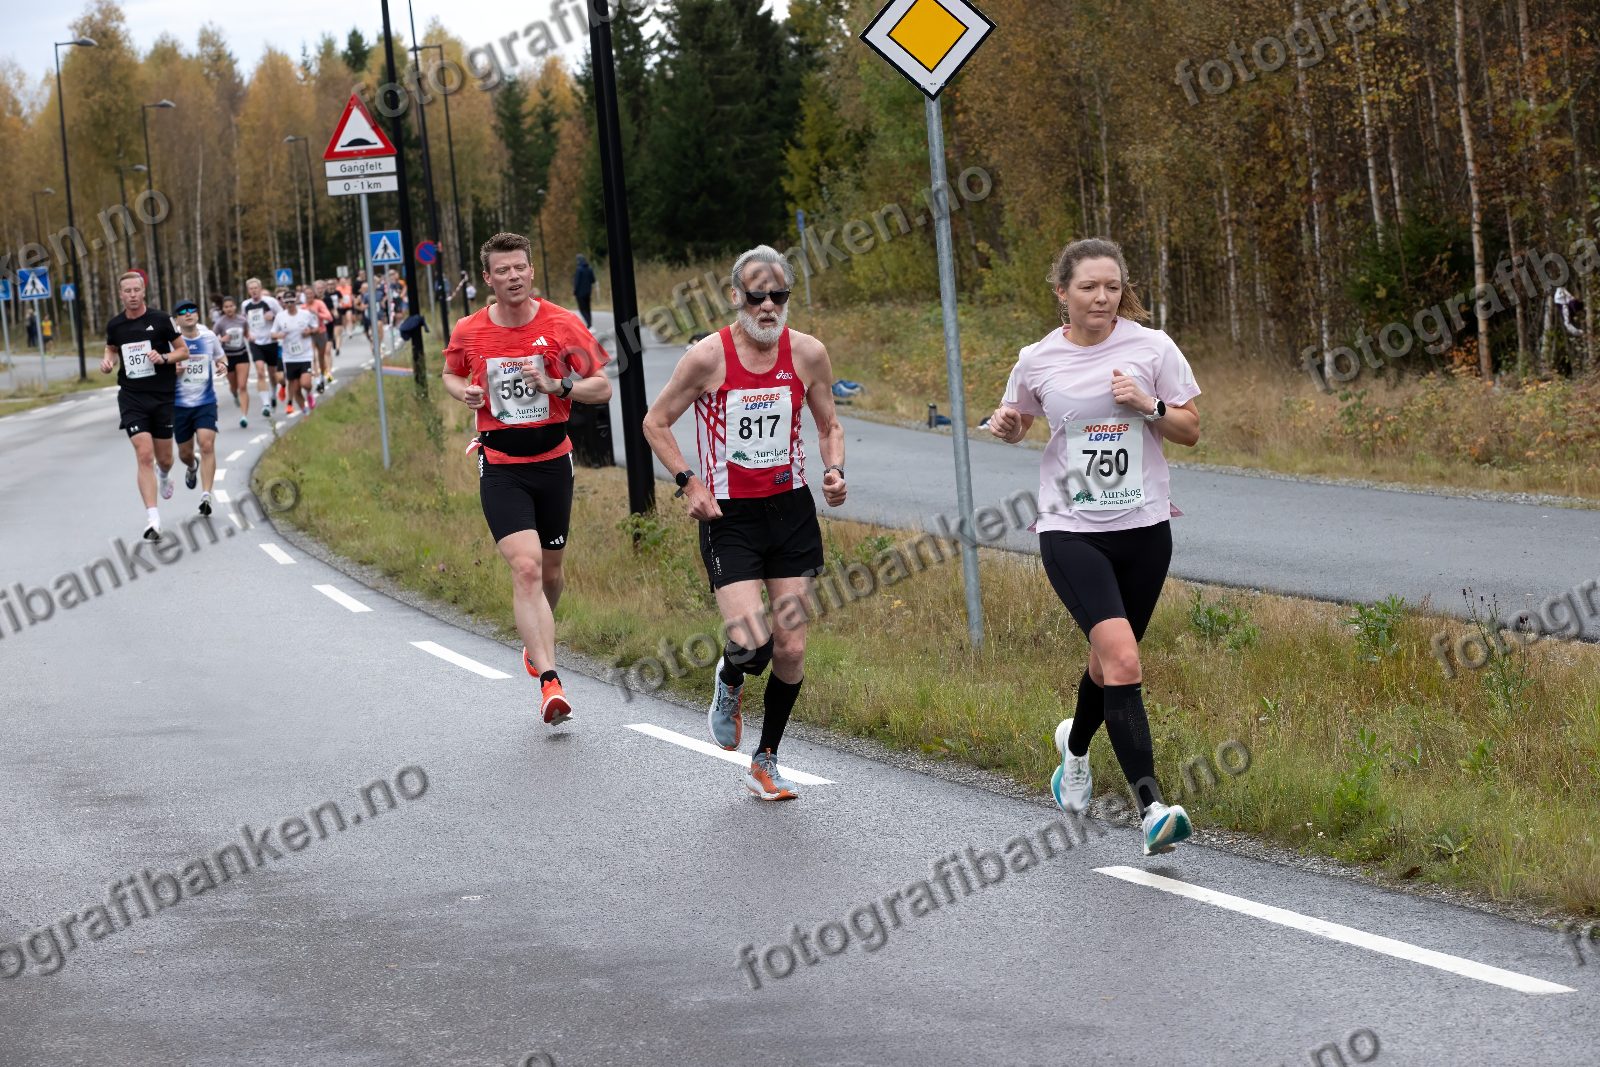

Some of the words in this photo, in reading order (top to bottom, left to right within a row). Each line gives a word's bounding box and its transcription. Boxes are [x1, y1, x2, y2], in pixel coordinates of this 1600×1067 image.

[340, 162, 382, 174] Gangfelt
[343, 182, 351, 192] 0
[128, 353, 147, 366] 367
[742, 393, 781, 403] NORGES
[515, 405, 548, 416] Aurskog
[745, 401, 775, 410] LØPET
[738, 414, 781, 440] 817
[1083, 423, 1130, 433] NORGES
[1088, 432, 1123, 442] LØPET
[754, 448, 788, 460] Aurskog
[1082, 448, 1129, 477] 750
[1100, 487, 1142, 499] Aurskog
